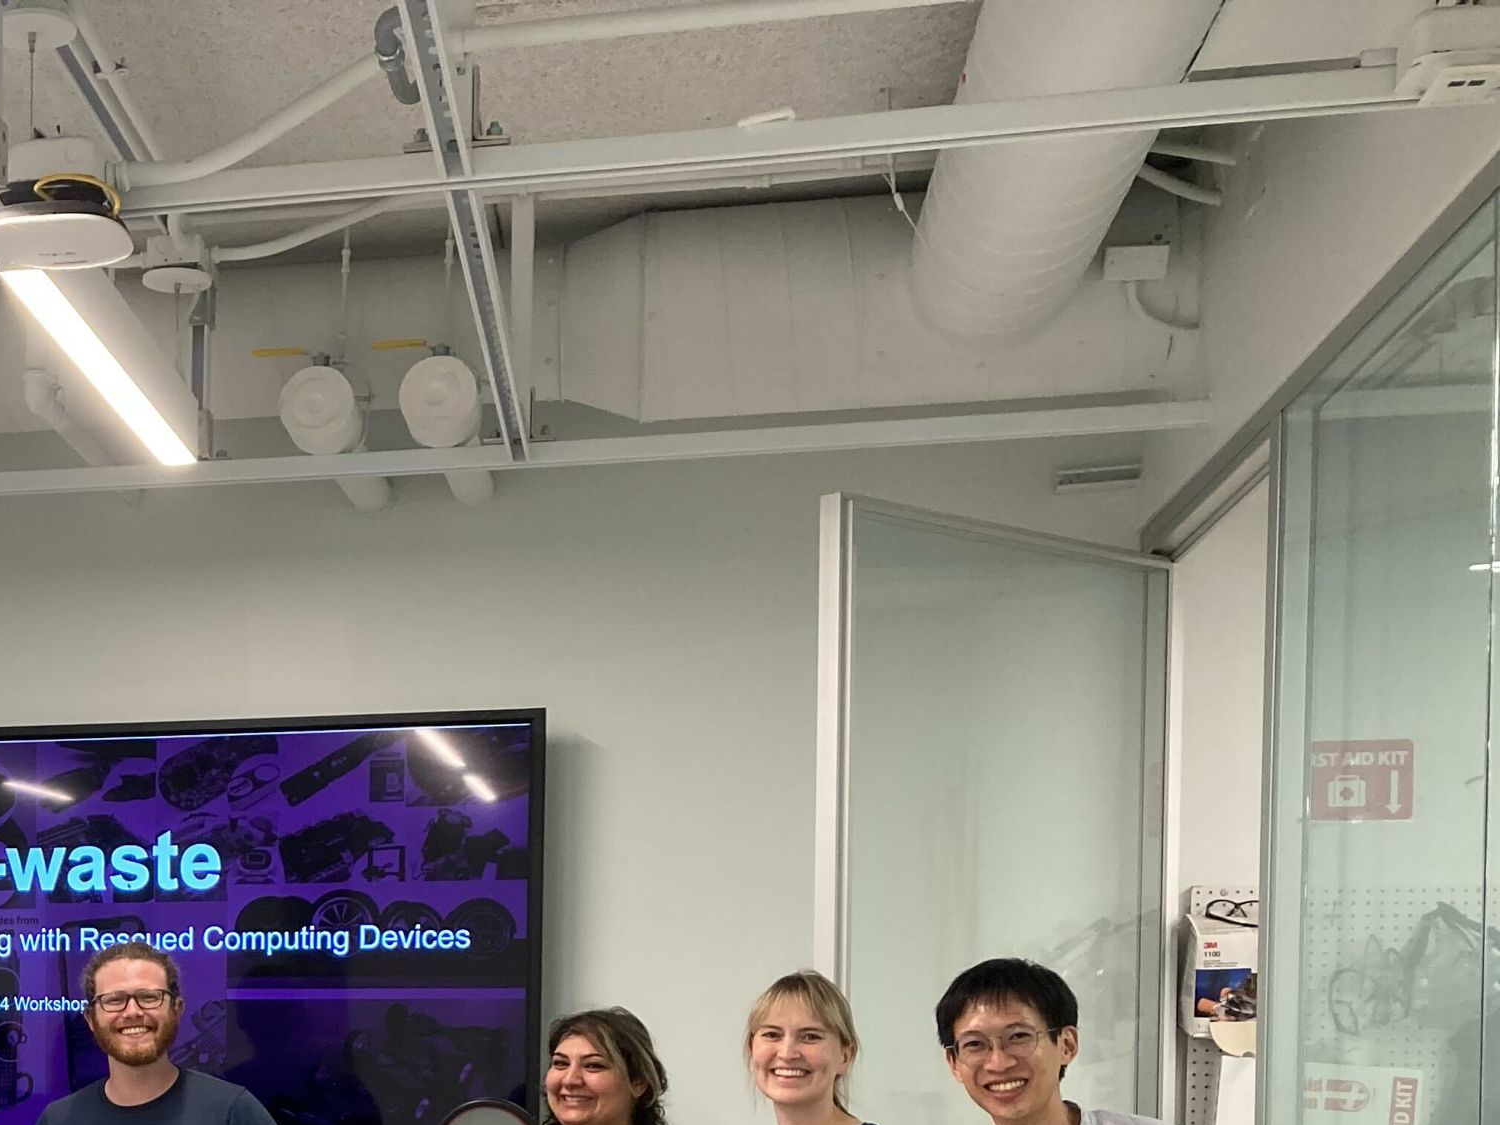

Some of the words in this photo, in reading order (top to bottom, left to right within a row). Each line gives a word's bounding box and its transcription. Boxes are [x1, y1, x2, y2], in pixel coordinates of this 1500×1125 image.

[1343, 751, 1375, 766] AID
[1378, 750, 1409, 766] KIT
[15, 926, 71, 952] with
[80, 926, 194, 951] Rescued
[203, 925, 350, 957] Computing
[359, 924, 472, 950] Devices
[1203, 941, 1218, 949] 3M
[1395, 1081, 1413, 1108] KIT
